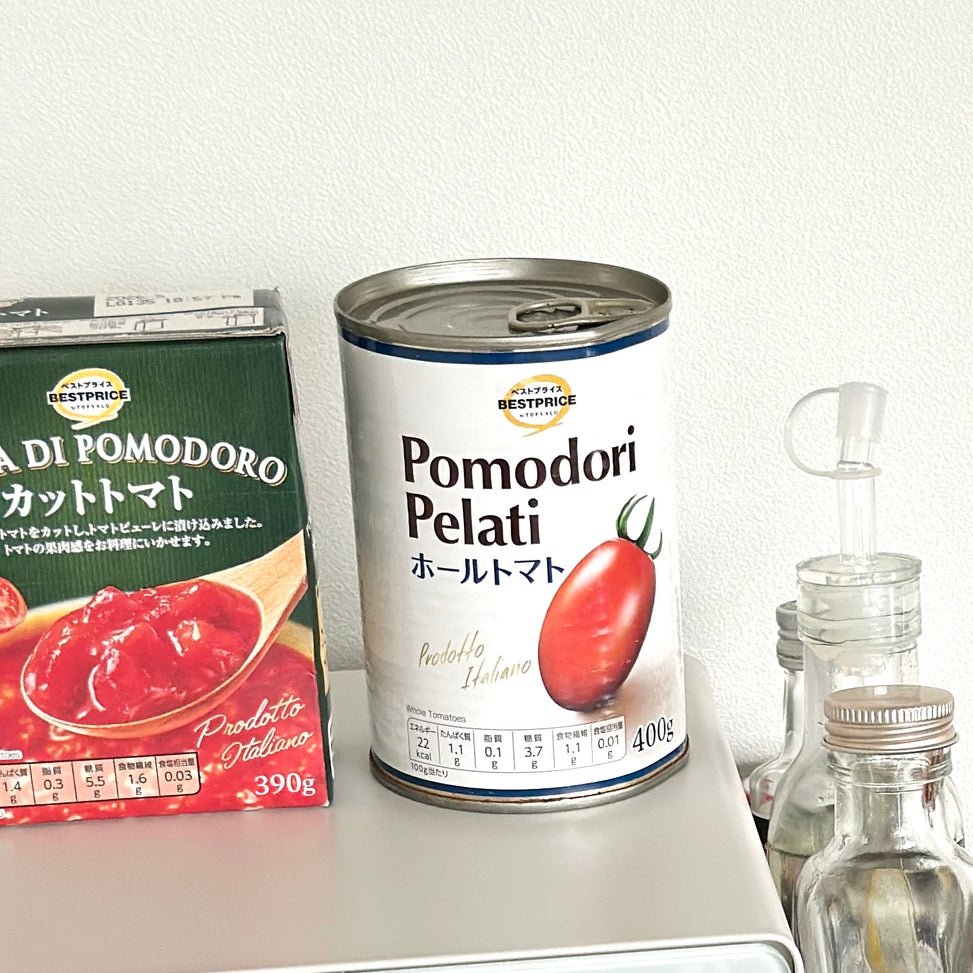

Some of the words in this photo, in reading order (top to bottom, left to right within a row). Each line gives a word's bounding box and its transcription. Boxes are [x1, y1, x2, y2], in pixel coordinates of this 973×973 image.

[49, 390, 128, 403] BESTPRICE
[61, 381, 113, 389] ベストプライス
[511, 386, 562, 395] ベストプライス
[498, 395, 576, 410] BESTPRICE
[22, 435, 69, 470] DI
[74, 432, 287, 486] POMODORO
[401, 424, 636, 490] Pomodori
[3, 476, 193, 518] カットトマト
[406, 492, 541, 546] Pelati
[411, 553, 565, 585] ホールトマト
[418, 630, 484, 668] Prodotto
[461, 657, 532, 690] Italiano
[195, 695, 305, 747] Prodotto
[428, 710, 466, 723] Tomatoes
[222, 728, 314, 769] Italiano
[417, 736, 430, 749] 22
[449, 743, 463, 755] 1.1
[485, 746, 501, 758] 0.1
[525, 746, 543, 757] 3.7
[565, 743, 580, 754] 1.1
[598, 734, 619, 749] 0.01
[632, 717, 674, 753] 400g
[416, 750, 432, 761] kcal
[454, 758, 460, 766] g
[492, 761, 498, 769] g
[531, 760, 538, 769] g
[607, 750, 613, 759] g
[3, 781, 21, 792] 1.4
[44, 779, 64, 790] 0.3
[86, 776, 105, 787] 5.5
[129, 773, 147, 784] 1.6
[165, 770, 193, 782] 0.03
[136, 787, 142, 795] g
[177, 784, 183, 792] g
[254, 772, 316, 797] 390g
